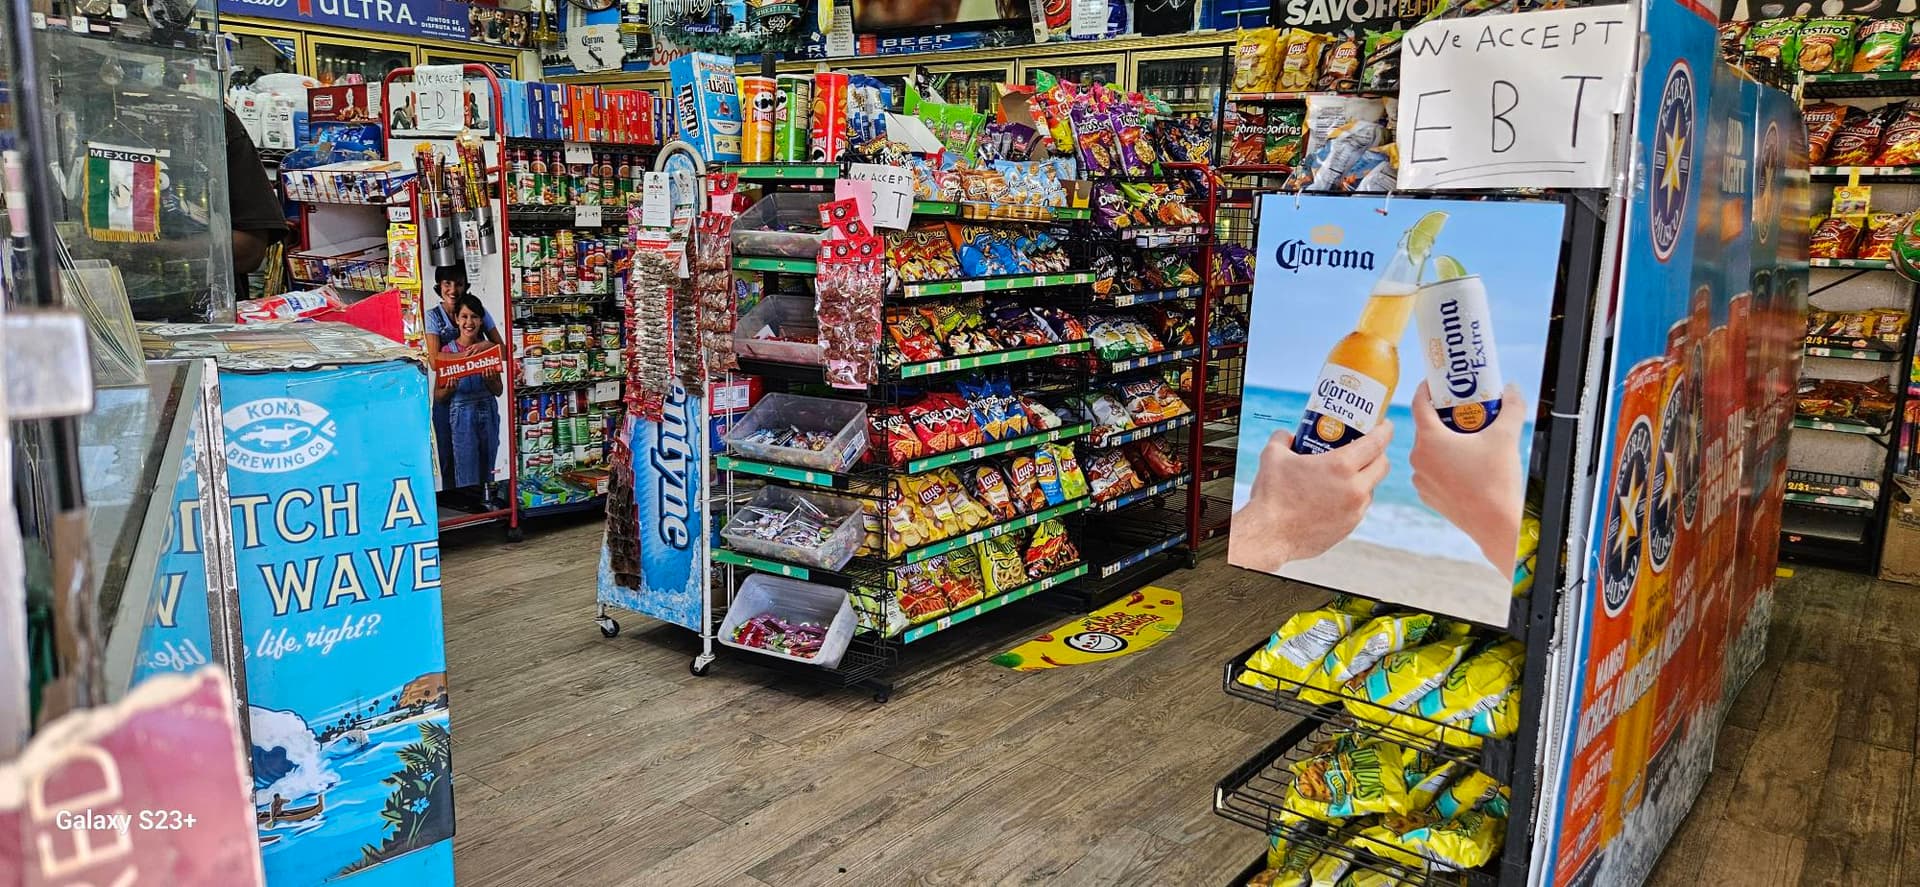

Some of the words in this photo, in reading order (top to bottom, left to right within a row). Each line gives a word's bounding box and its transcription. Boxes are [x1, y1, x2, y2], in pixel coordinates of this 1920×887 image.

[318, 0, 415, 25] ULTRA
[426, 15, 450, 24] JUNTOS
[421, 22, 451, 31] DISFRUTA
[883, 34, 952, 47] BEER
[1288, 42, 1306, 55] Lay's
[1408, 28, 1462, 58] We
[1474, 19, 1623, 54] ACCEPT
[1335, 47, 1356, 59] Lay's
[416, 70, 432, 86] We
[419, 89, 460, 121] EBT
[1410, 74, 1603, 164] EBT
[89, 149, 153, 164] MEXICO
[871, 172, 913, 187] ACCEPT
[1275, 239, 1375, 273] Corona
[1440, 299, 1477, 399] Corona
[1469, 320, 1487, 370] Extra
[439, 362, 467, 378] Little
[466, 355, 500, 372] Debbie
[1317, 378, 1375, 416] Corona
[246, 402, 302, 419] KONA
[1323, 397, 1354, 420] Extra
[227, 448, 305, 469] BREWING
[651, 380, 694, 550] entyne
[980, 469, 1001, 490] Lay's
[1016, 462, 1034, 482] Lay's
[919, 483, 942, 504] Lay's
[1787, 481, 1810, 491] 2/$1
[382, 477, 426, 532] A
[257, 540, 442, 616] WAVE
[256, 629, 302, 658] life,
[304, 614, 383, 655] right?
